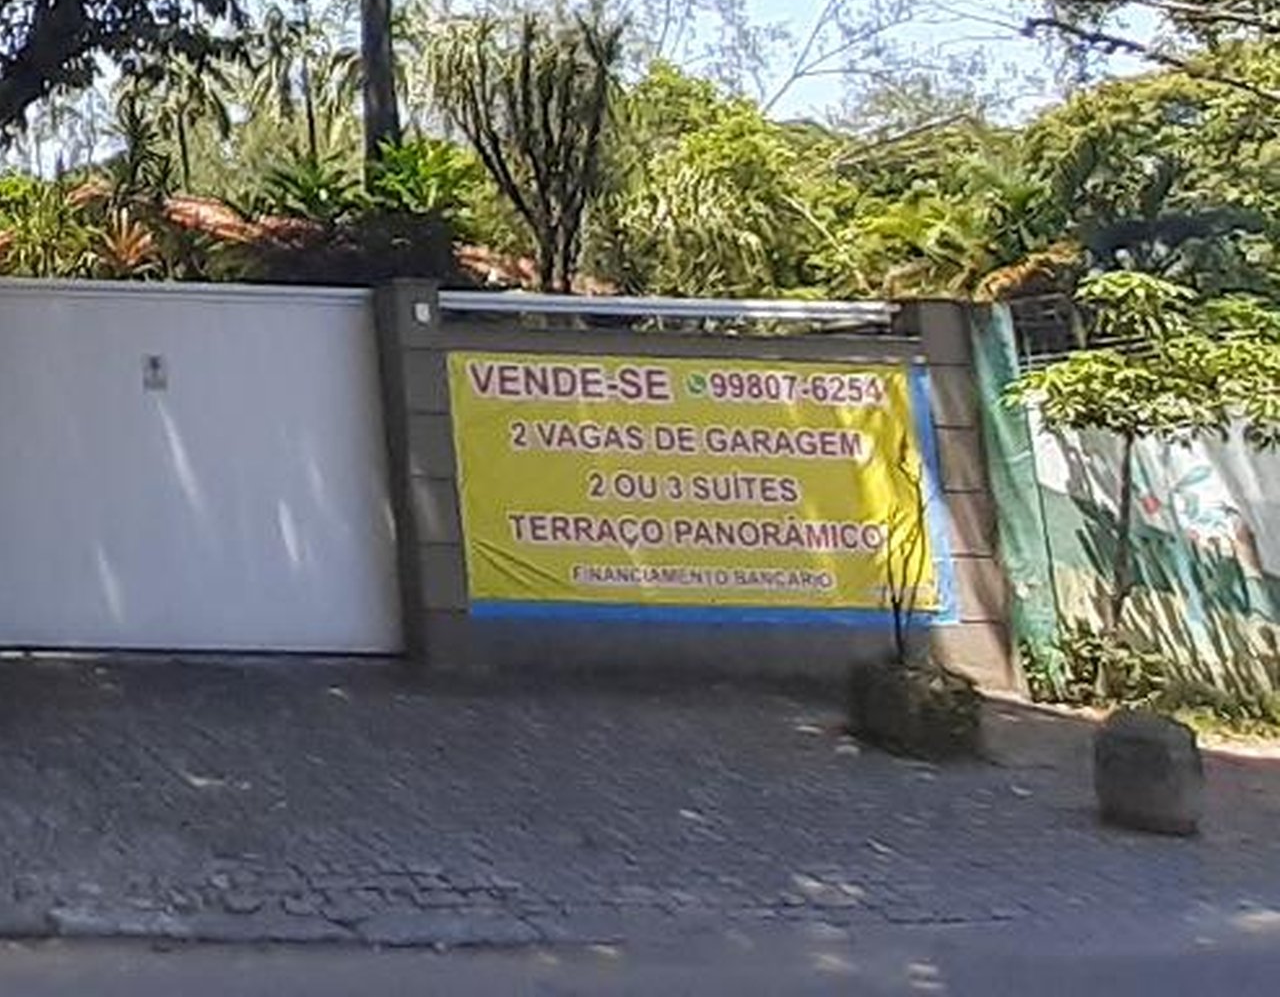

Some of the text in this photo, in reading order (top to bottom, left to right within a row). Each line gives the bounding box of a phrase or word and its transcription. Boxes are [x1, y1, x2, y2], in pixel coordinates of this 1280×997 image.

[469, 363, 884, 402] VENDE-SE 99807-6254
[511, 422, 863, 457] 2 VAGAS DE GARAGEM
[589, 470, 799, 502] 2 OU 3 SUÍTES
[508, 514, 884, 550] TERRAÇO PANORÂMICO
[572, 564, 730, 586] FINANCIAMENTO
